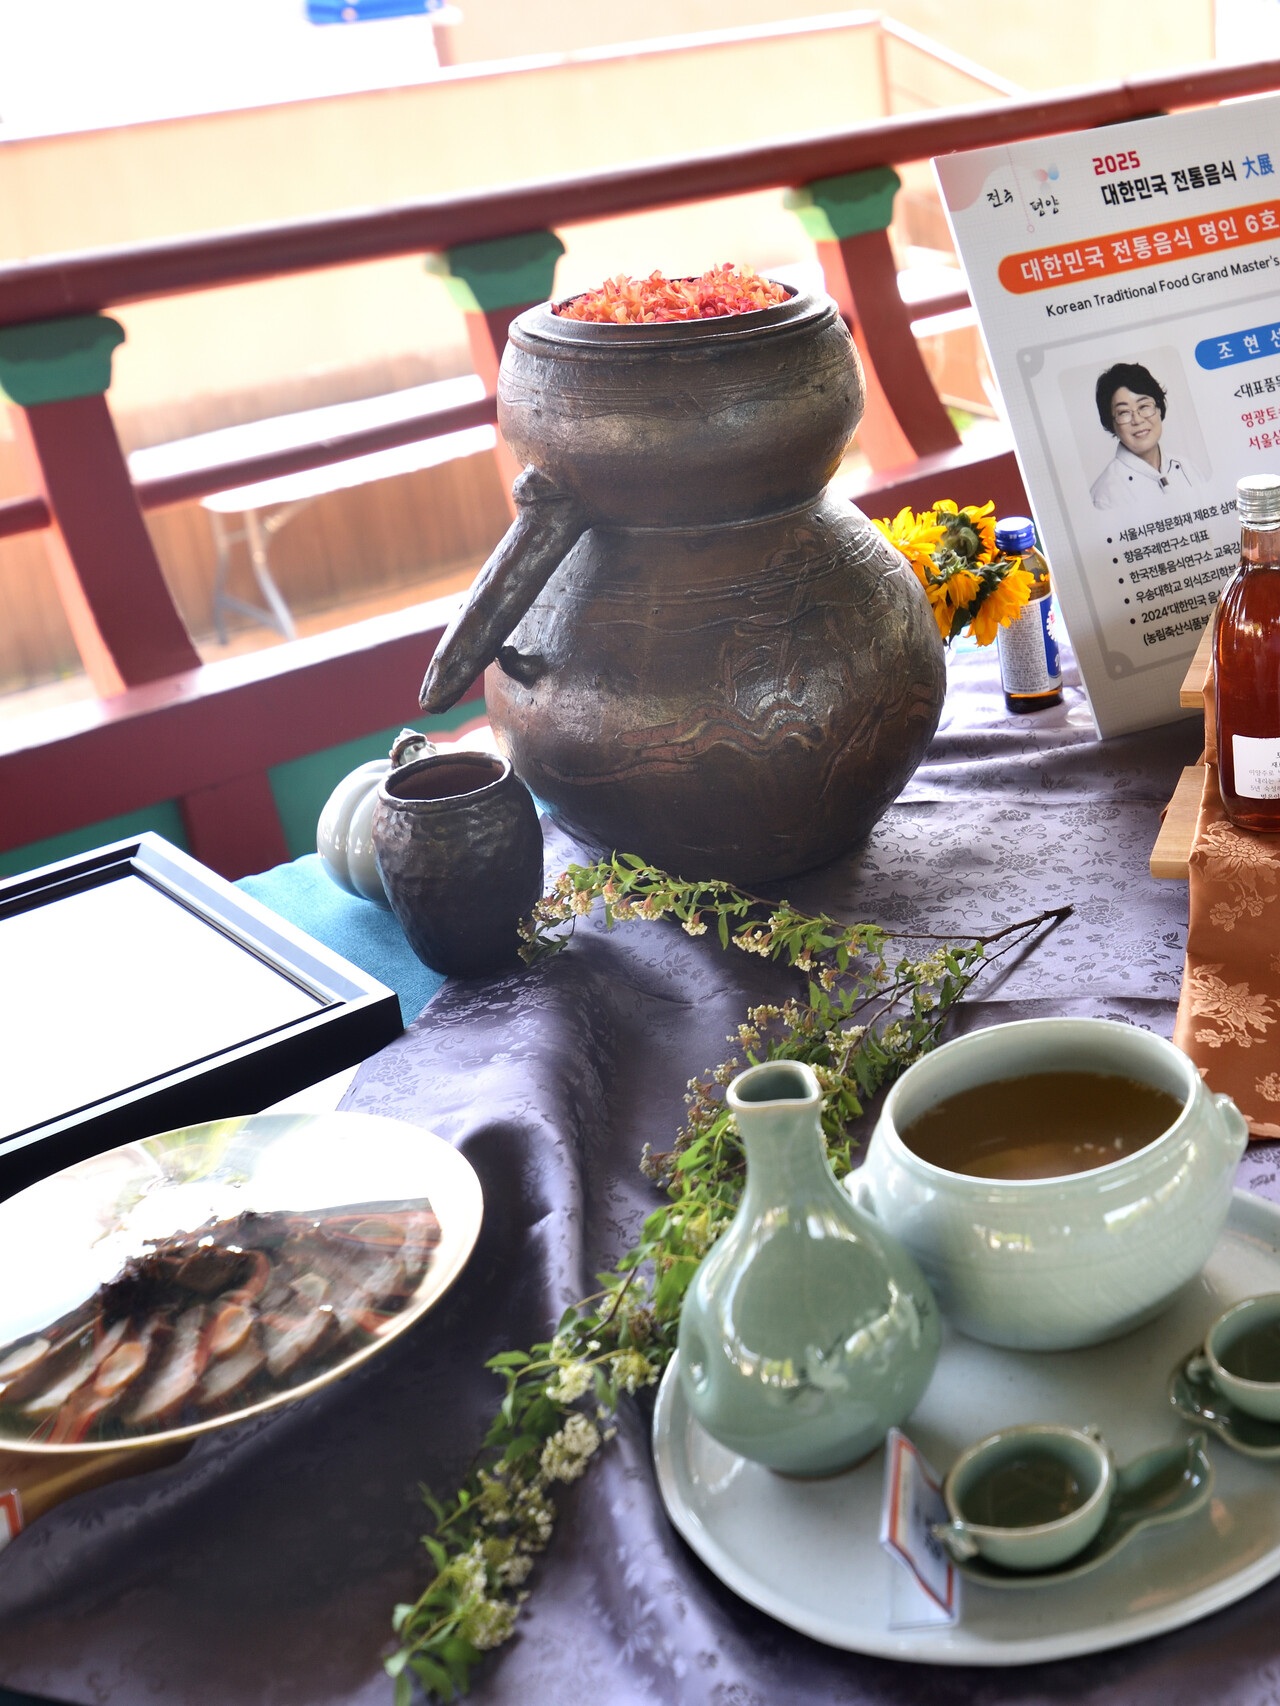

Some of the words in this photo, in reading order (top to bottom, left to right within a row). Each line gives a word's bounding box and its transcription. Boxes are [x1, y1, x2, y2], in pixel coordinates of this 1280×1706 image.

[1092, 151, 1140, 175] 2025
[1100, 174, 1168, 206] 대한민국
[1171, 160, 1237, 192] 전통음식
[1242, 153, 1274, 179] 大展
[1020, 246, 1105, 282] 대한민국
[1112, 227, 1193, 264] 전통음식
[1198, 216, 1239, 245] 명인
[1245, 210, 1280, 234] 6호
[1045, 298, 1092, 317] Korean
[1093, 281, 1158, 307] Traditional
[1159, 275, 1190, 293] Food
[1191, 266, 1229, 285] Grand
[1230, 255, 1280, 275] Master's
[1119, 512, 1193, 542] 서울시무형문화재
[1194, 506, 1219, 521] 제8호
[1123, 536, 1190, 564] 향음주례연구소
[1190, 530, 1210, 544] 대표
[1129, 550, 1214, 584] 한국전통음식연구소
[1136, 580, 1183, 604] 우송대학교
[1143, 614, 1211, 646] (농림축산식품부
